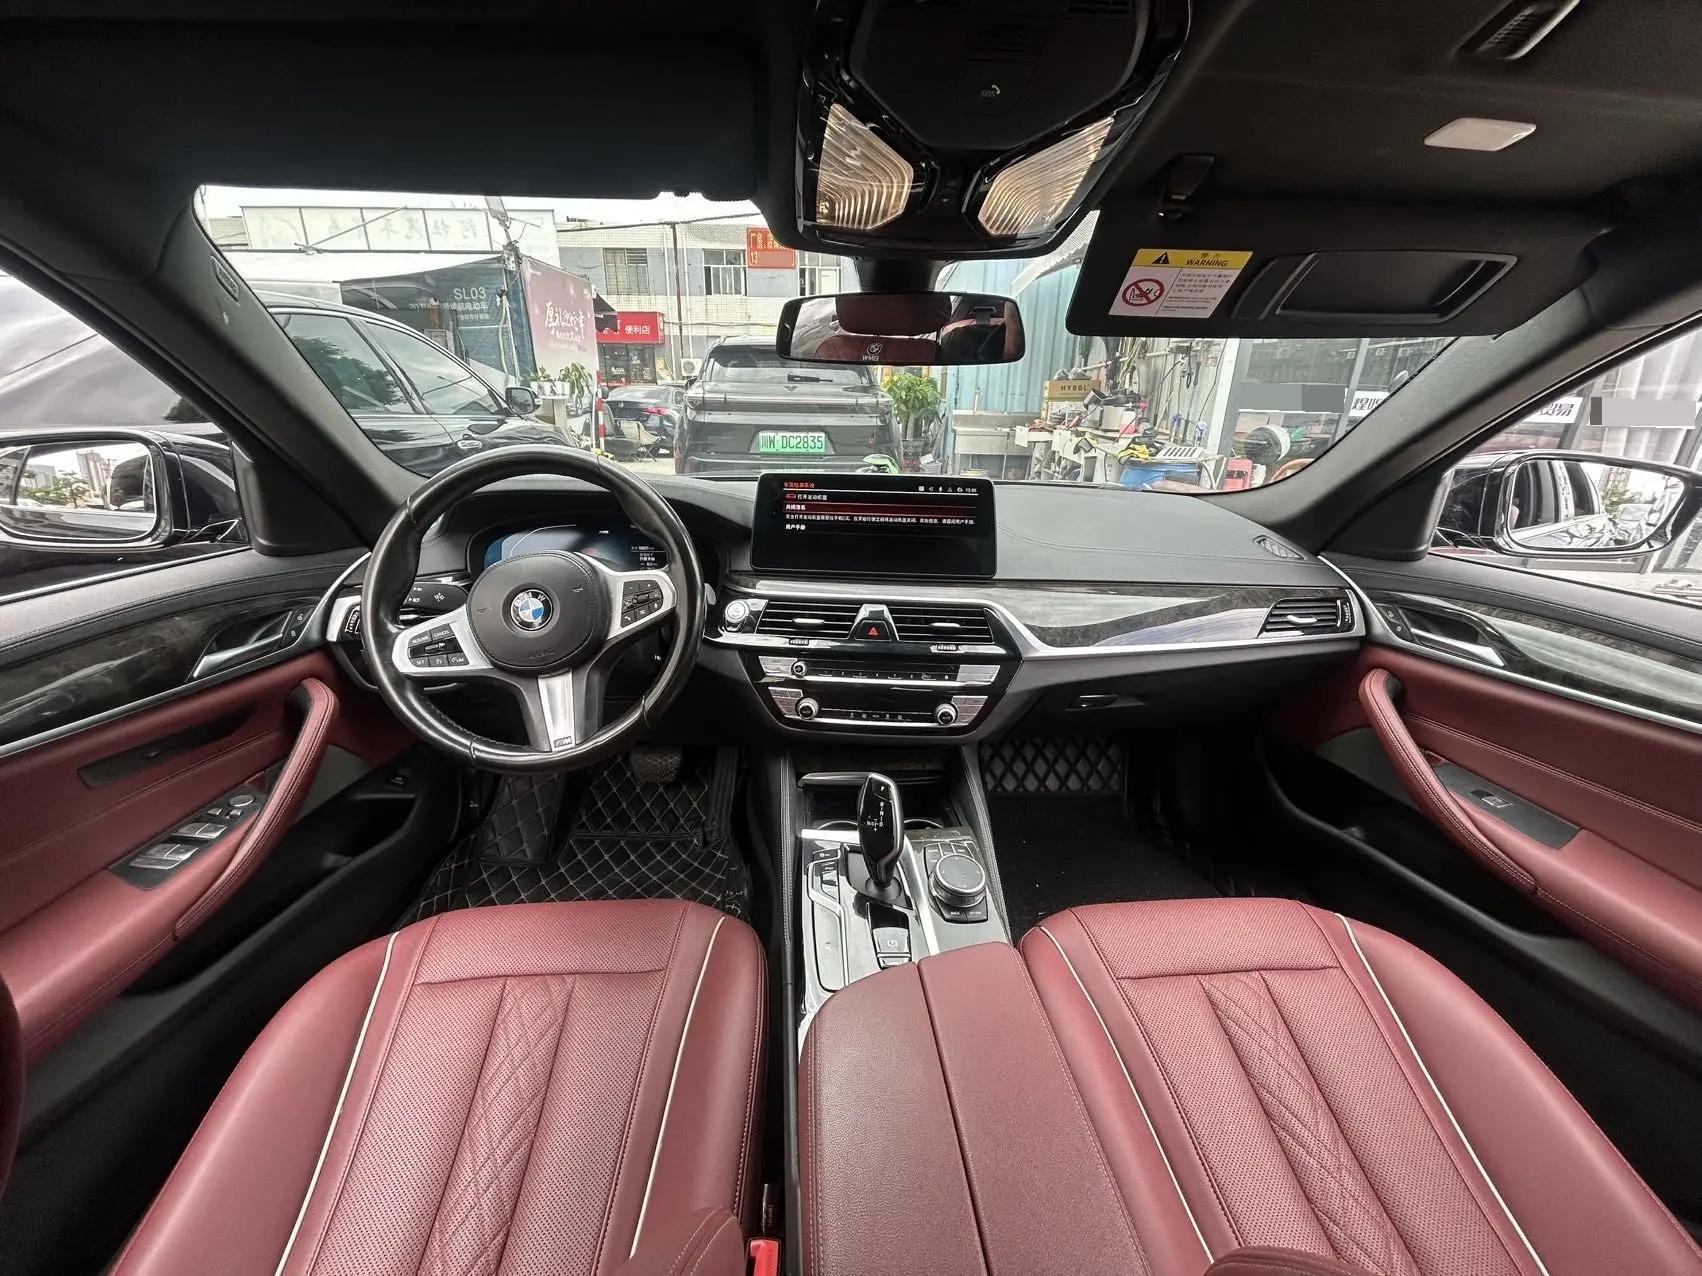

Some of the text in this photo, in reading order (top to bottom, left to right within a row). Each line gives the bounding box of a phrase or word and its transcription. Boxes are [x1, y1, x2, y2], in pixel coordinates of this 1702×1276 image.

[1186, 258, 1229, 267] WARNING
[453, 286, 487, 300] SL03
[624, 325, 651, 335] 便利店
[781, 435, 823, 449] DC2835
[514, 591, 546, 607] BMW
